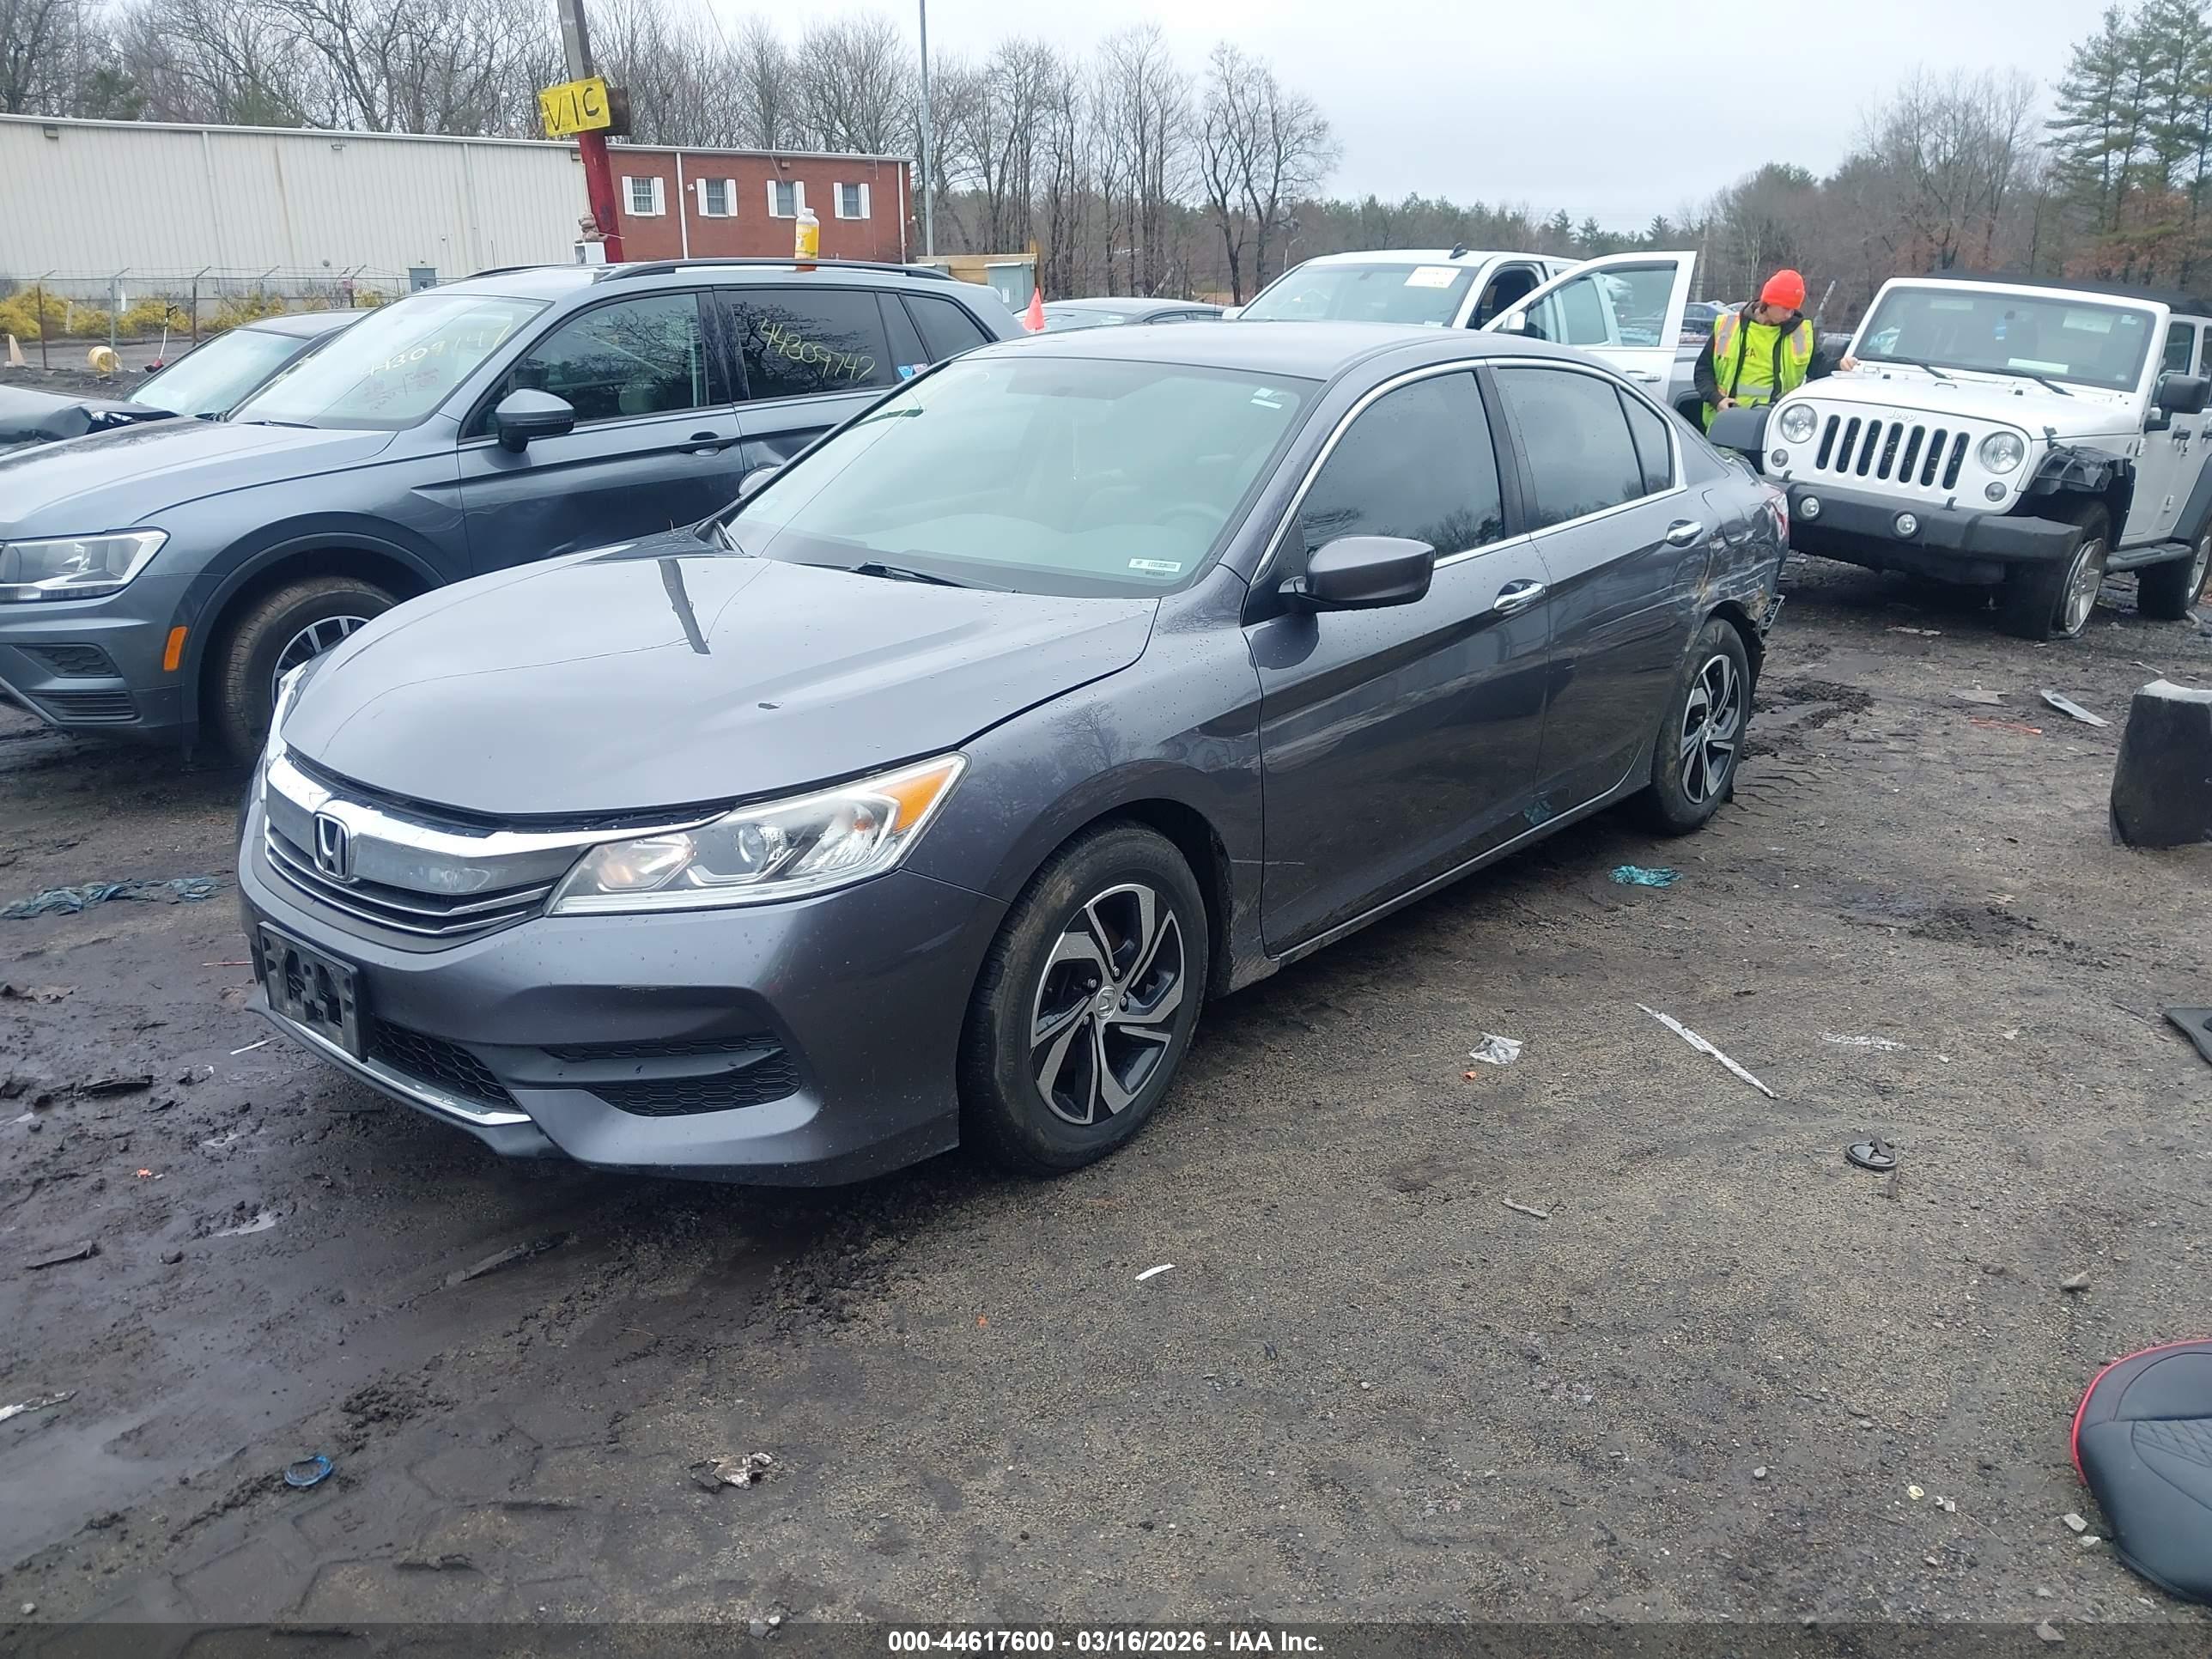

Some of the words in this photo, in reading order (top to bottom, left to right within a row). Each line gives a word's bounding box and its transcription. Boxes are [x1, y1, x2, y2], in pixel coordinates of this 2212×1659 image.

[545, 87, 599, 131] VIC
[760, 317, 876, 383] 44309747
[1887, 409, 1917, 424] Jeep
